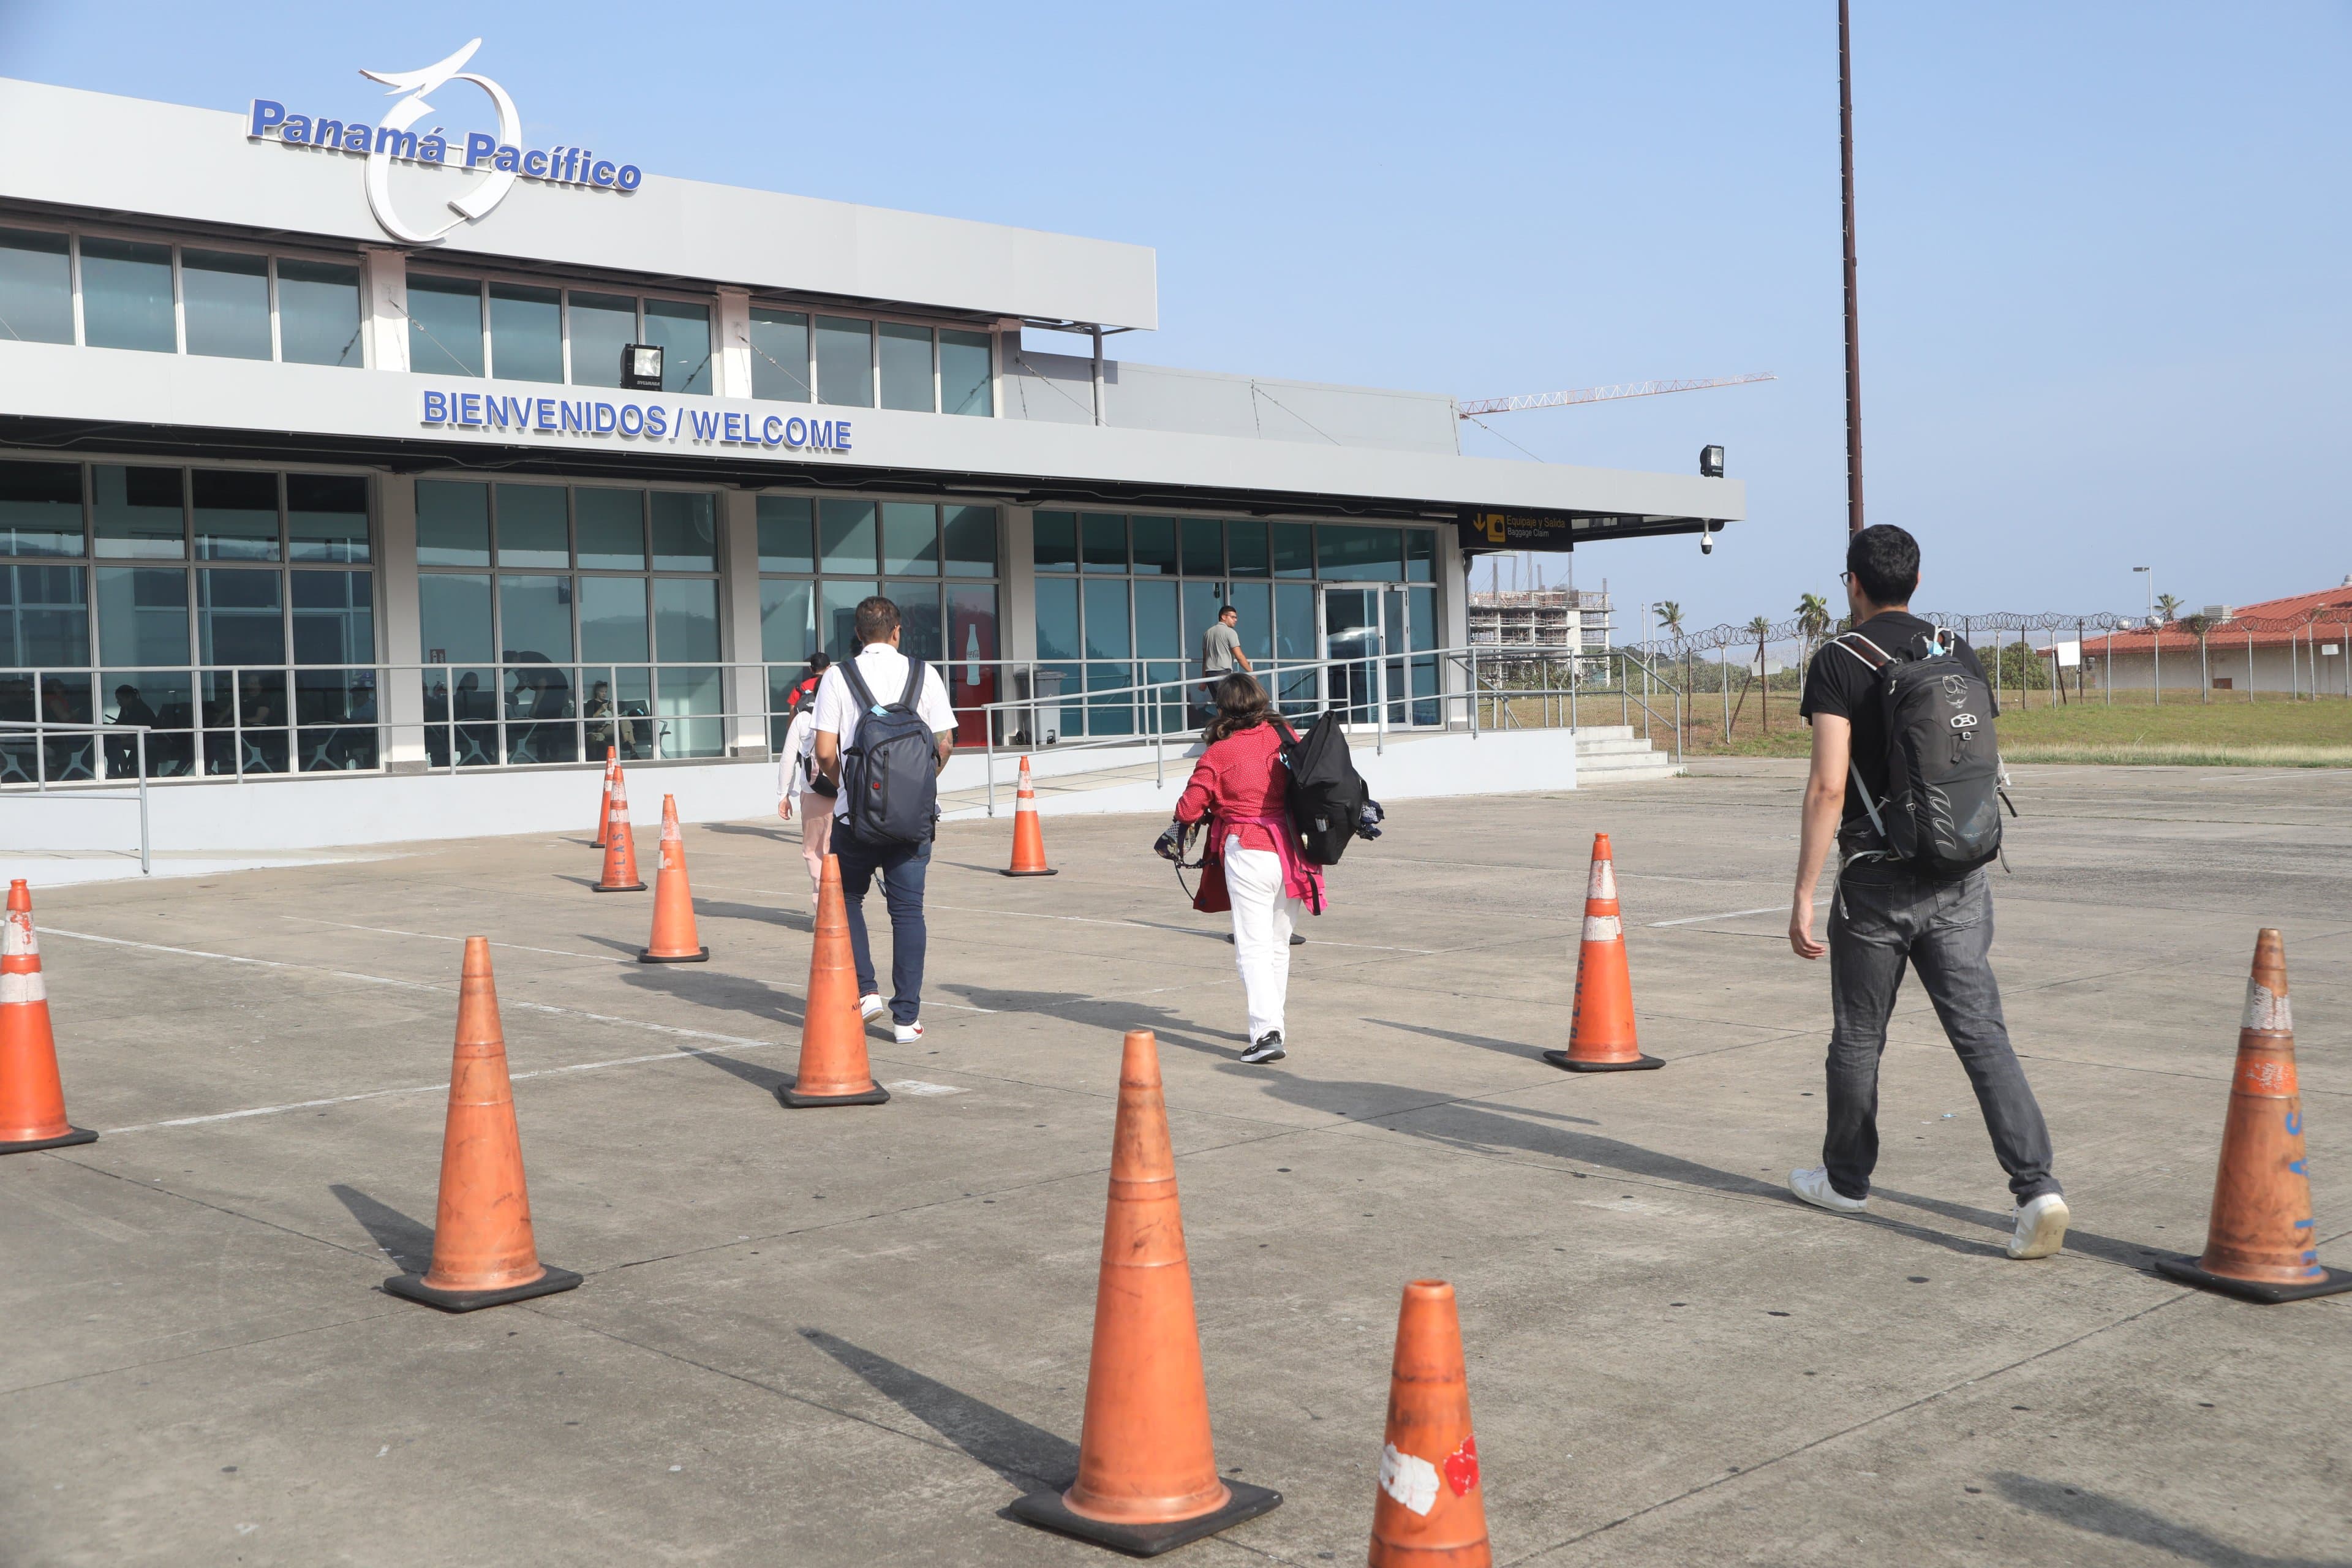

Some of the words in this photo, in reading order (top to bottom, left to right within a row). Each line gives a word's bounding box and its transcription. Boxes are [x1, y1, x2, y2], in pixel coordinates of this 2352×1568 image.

[252, 98, 447, 163] Panamá
[465, 131, 642, 190] Pacífico
[1506, 514, 1537, 529] Equipaje
[1538, 519, 1543, 529] y
[1544, 517, 1566, 528] Salida
[1507, 527, 1532, 538] Baggage
[1533, 529, 1549, 537] Claim
